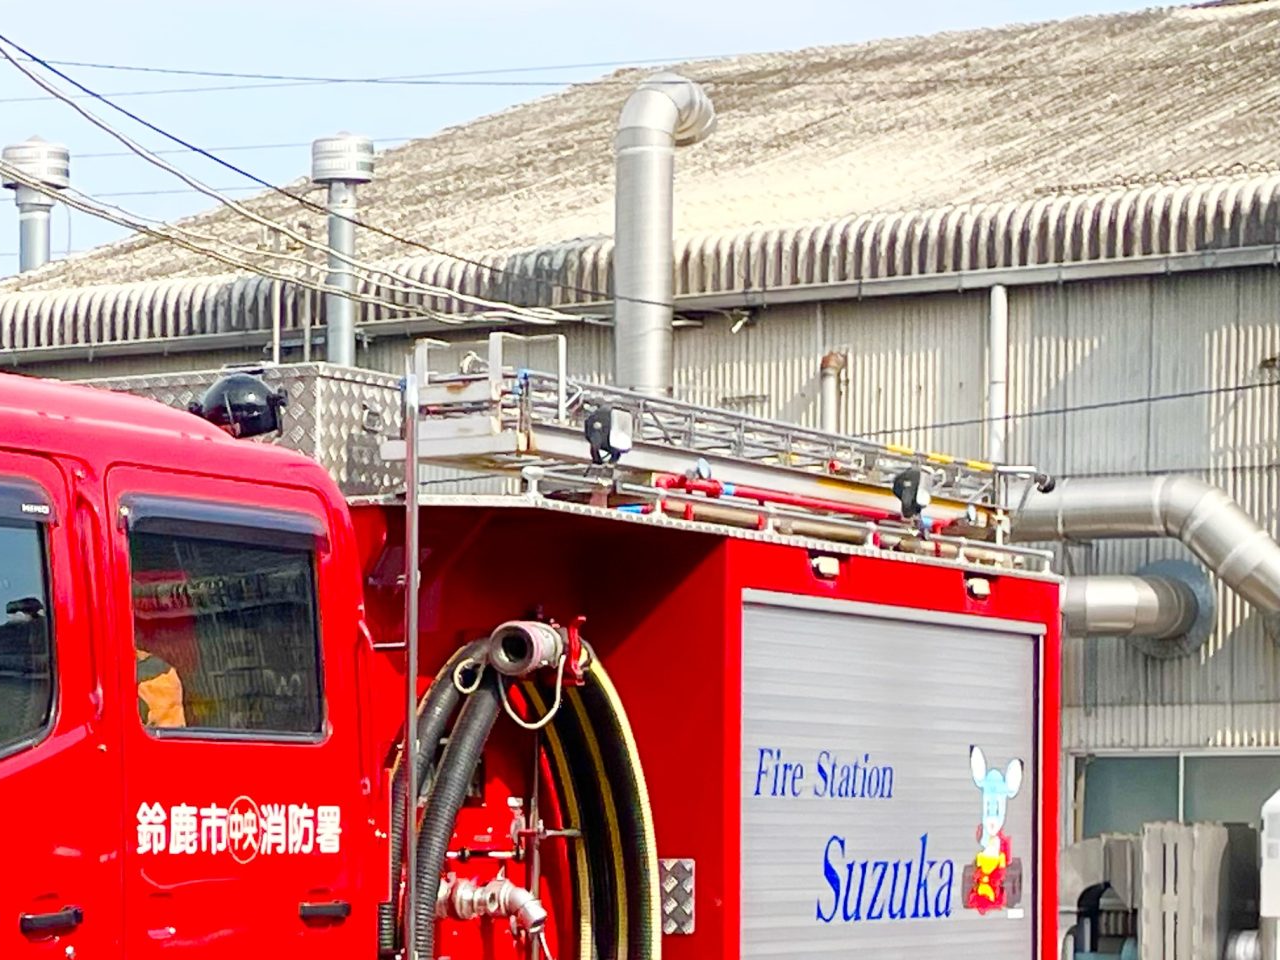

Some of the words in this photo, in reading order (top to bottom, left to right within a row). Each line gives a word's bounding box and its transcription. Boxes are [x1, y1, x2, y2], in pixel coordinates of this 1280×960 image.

[753, 747, 805, 798] Fire
[813, 750, 895, 799] Station
[816, 831, 956, 923] Suzuka
